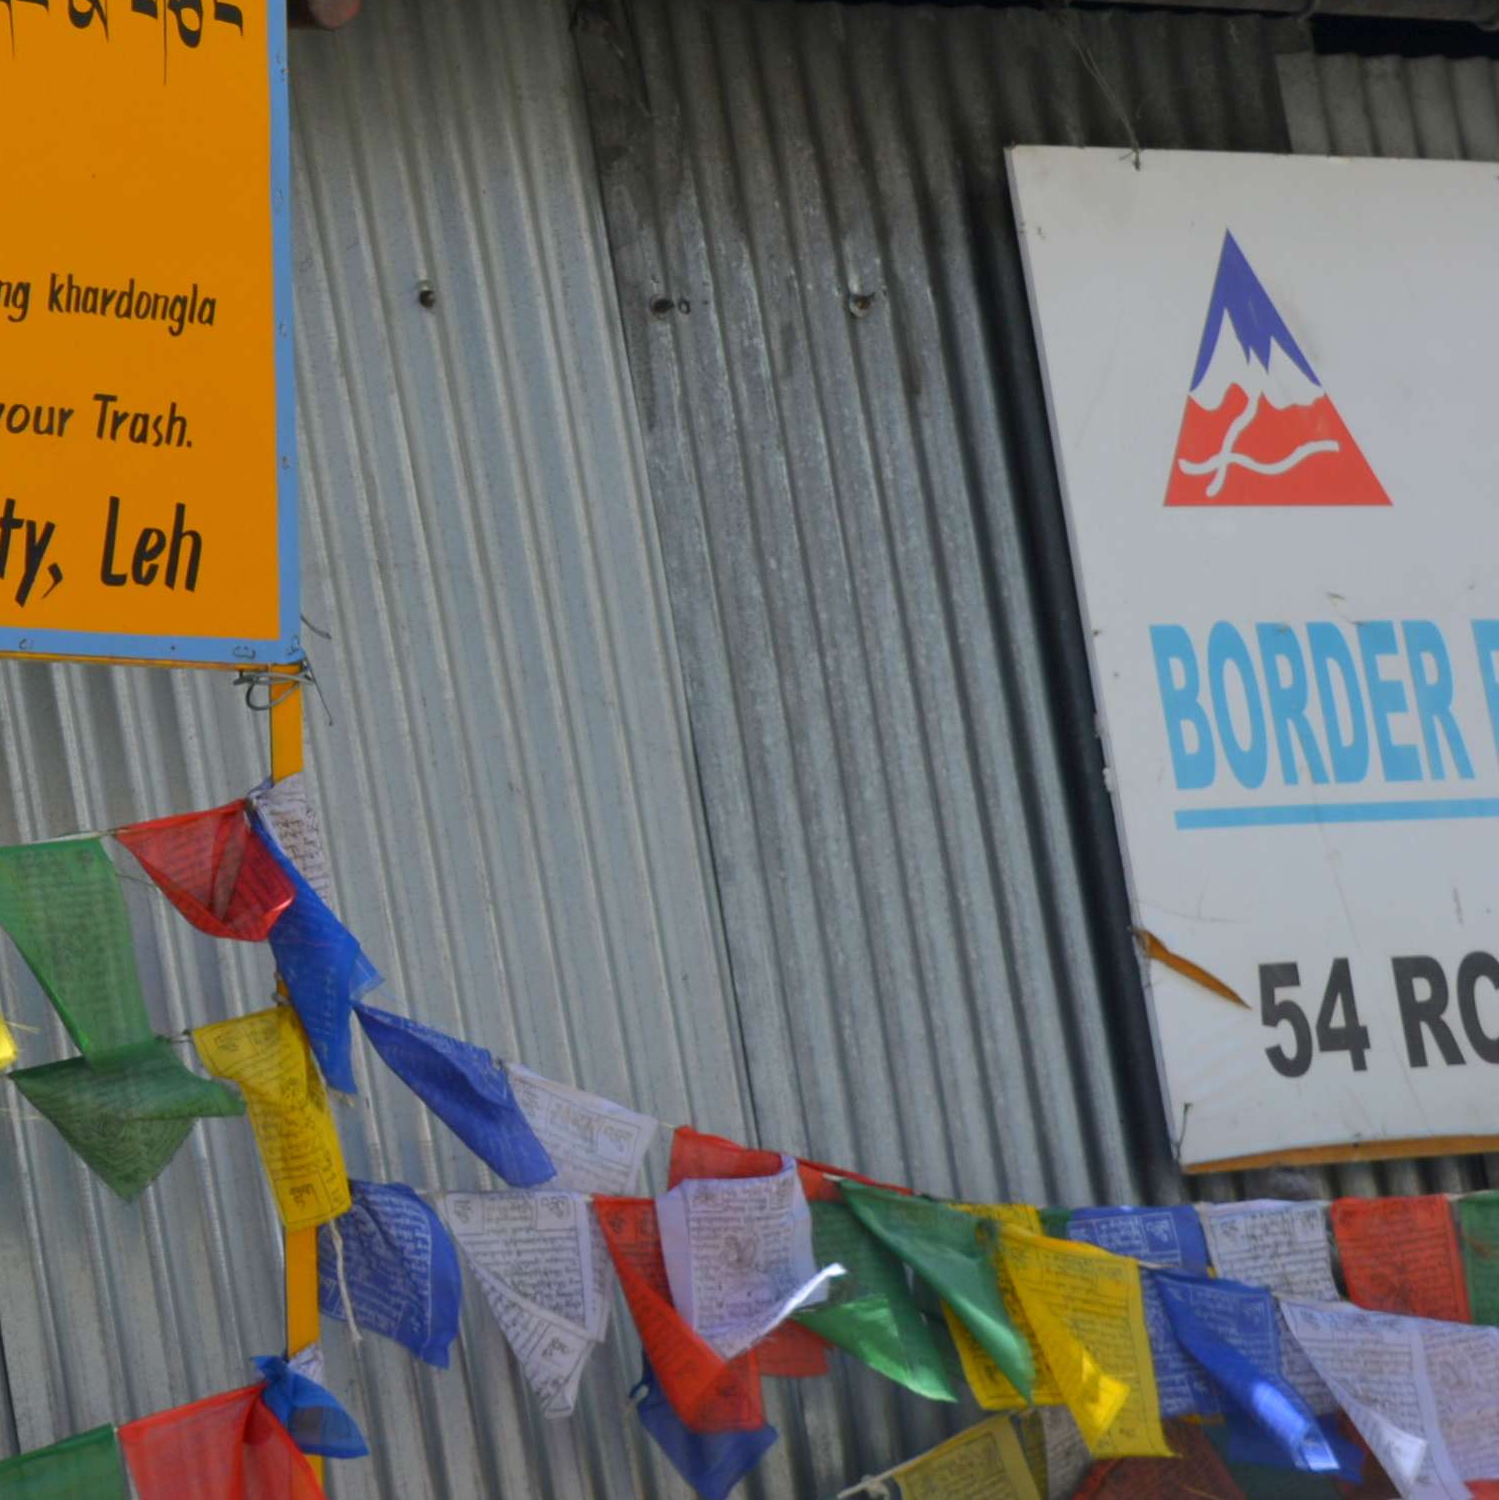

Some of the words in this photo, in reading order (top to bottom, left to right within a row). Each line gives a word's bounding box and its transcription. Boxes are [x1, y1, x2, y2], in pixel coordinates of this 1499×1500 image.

[49, 274, 216, 336] khardongla
[94, 394, 191, 447] Trash.
[101, 496, 202, 592] Leh
[1149, 620, 1476, 790] BORDER
[1258, 957, 1371, 1078] 54
